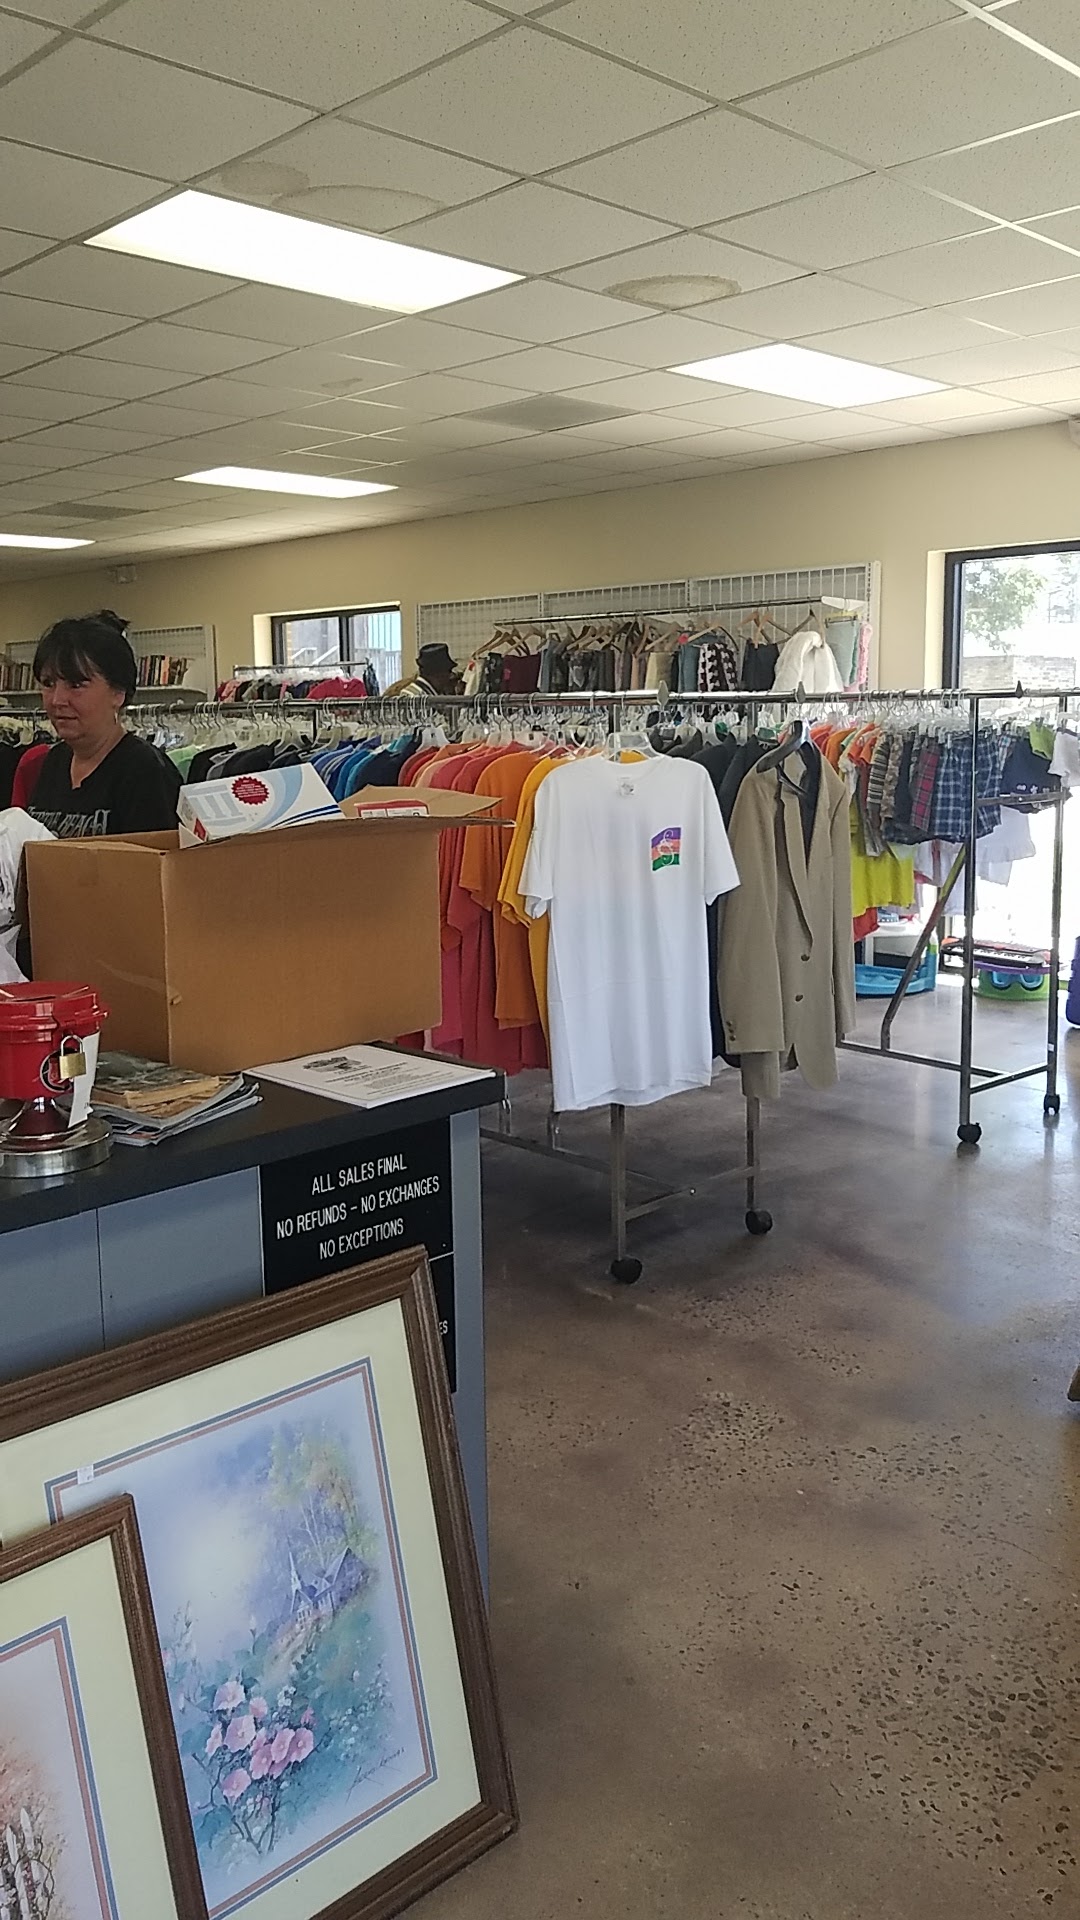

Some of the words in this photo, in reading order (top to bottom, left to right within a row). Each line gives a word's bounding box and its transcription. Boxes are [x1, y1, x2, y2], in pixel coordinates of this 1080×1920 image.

[311, 1173, 336, 1196] ALL
[338, 1161, 375, 1188] SALES
[377, 1153, 408, 1177] FINAL
[276, 1218, 294, 1240] NO
[296, 1202, 347, 1234] REFUNDS
[361, 1194, 376, 1214] NO
[378, 1175, 440, 1209] EXCHANGES
[319, 1239, 336, 1260] NO
[338, 1218, 404, 1254] EXCEPTIONS
